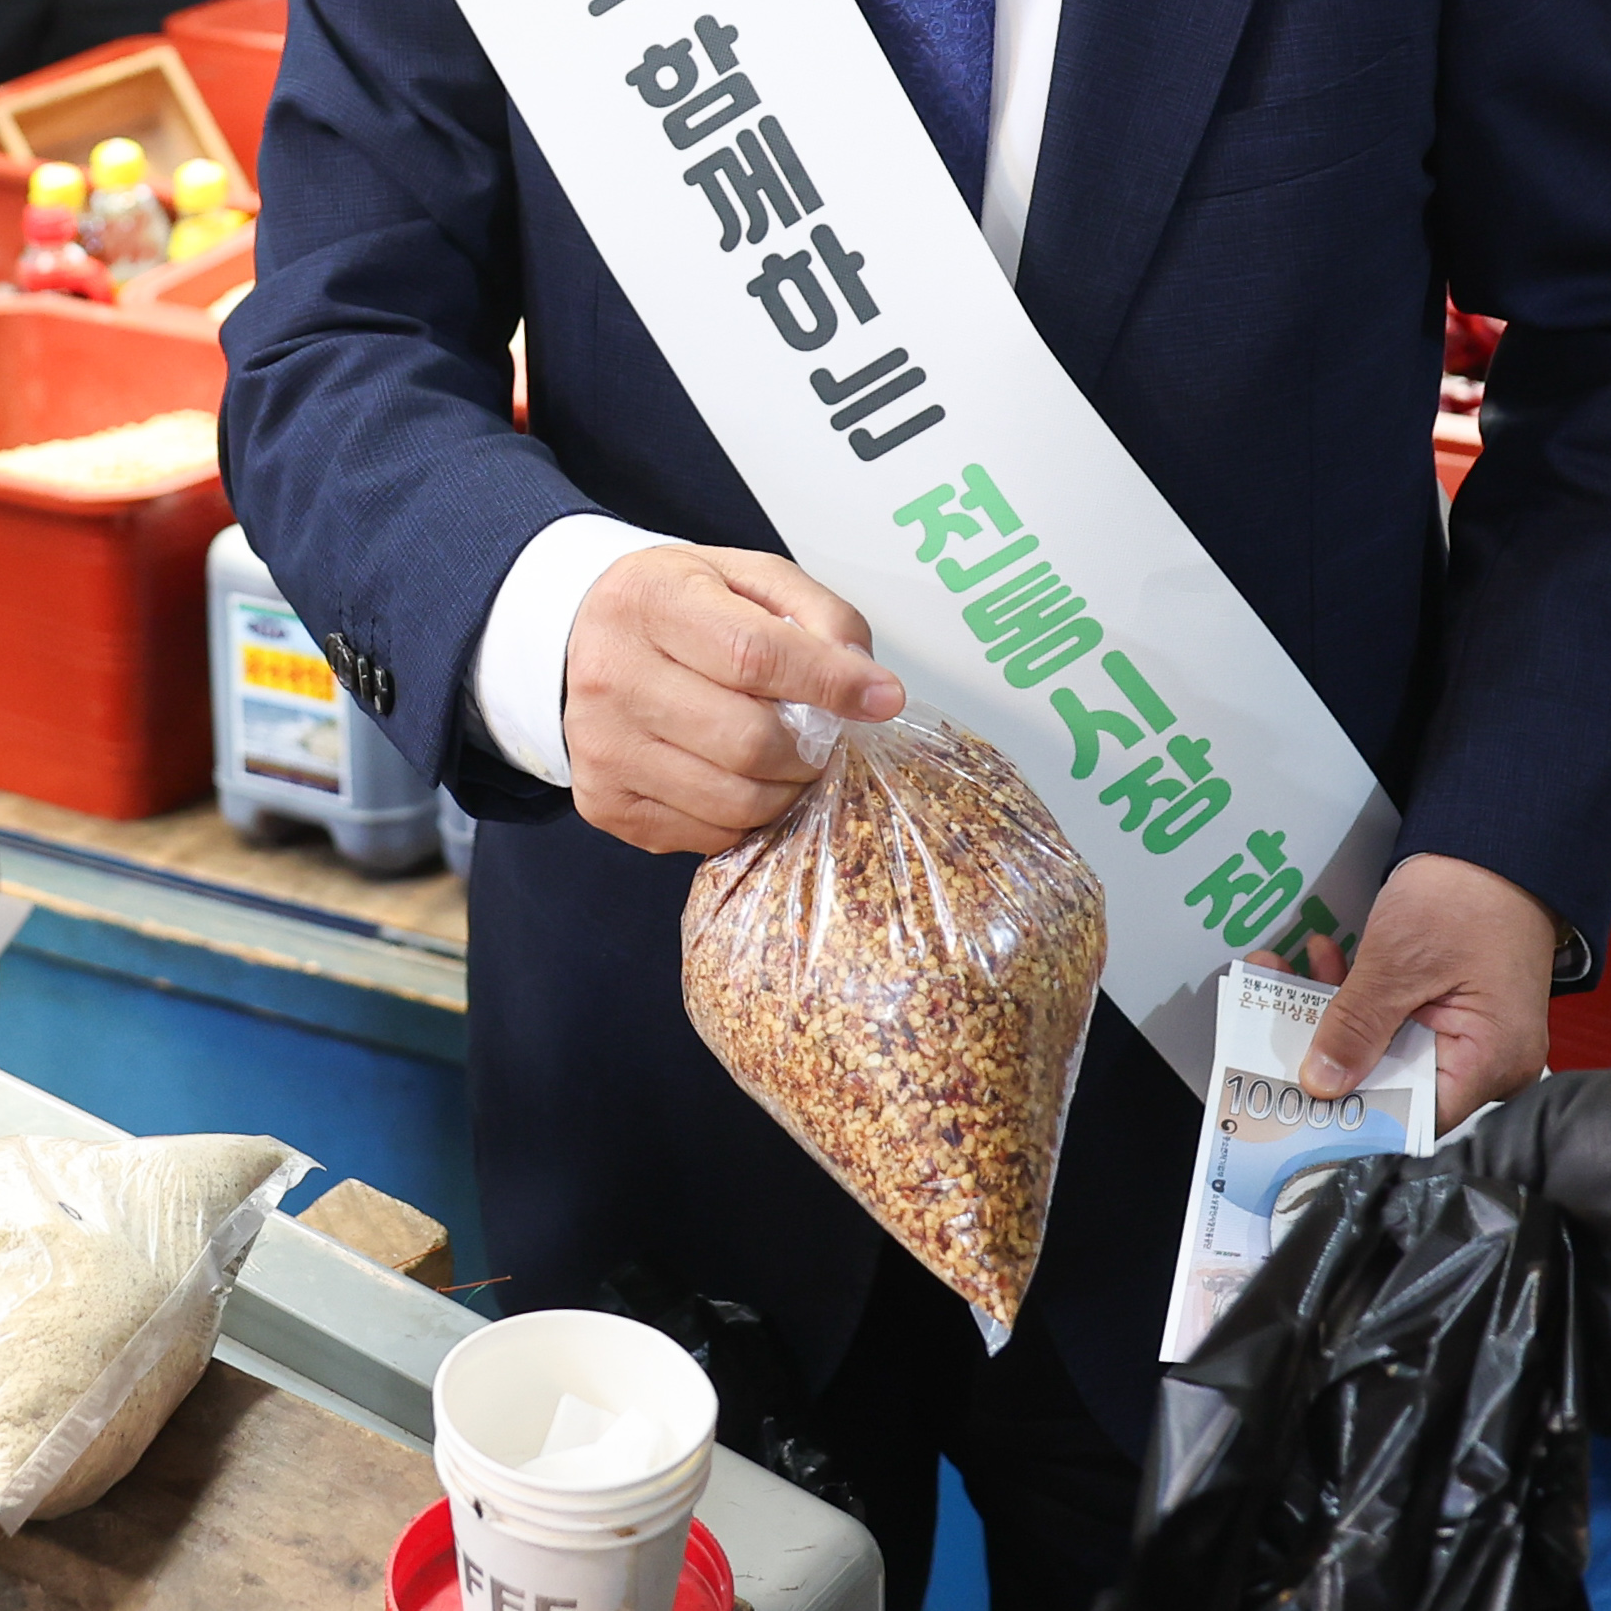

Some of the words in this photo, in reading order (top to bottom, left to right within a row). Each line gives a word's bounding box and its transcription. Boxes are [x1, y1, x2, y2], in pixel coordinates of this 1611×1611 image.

[625, 15, 946, 461] 함께하는
[892, 462, 1232, 855] 전통시장
[1239, 991, 1320, 1025] 온누리상품
[1242, 977, 1283, 997] 전통시장
[1224, 1074, 1367, 1132] 10000
